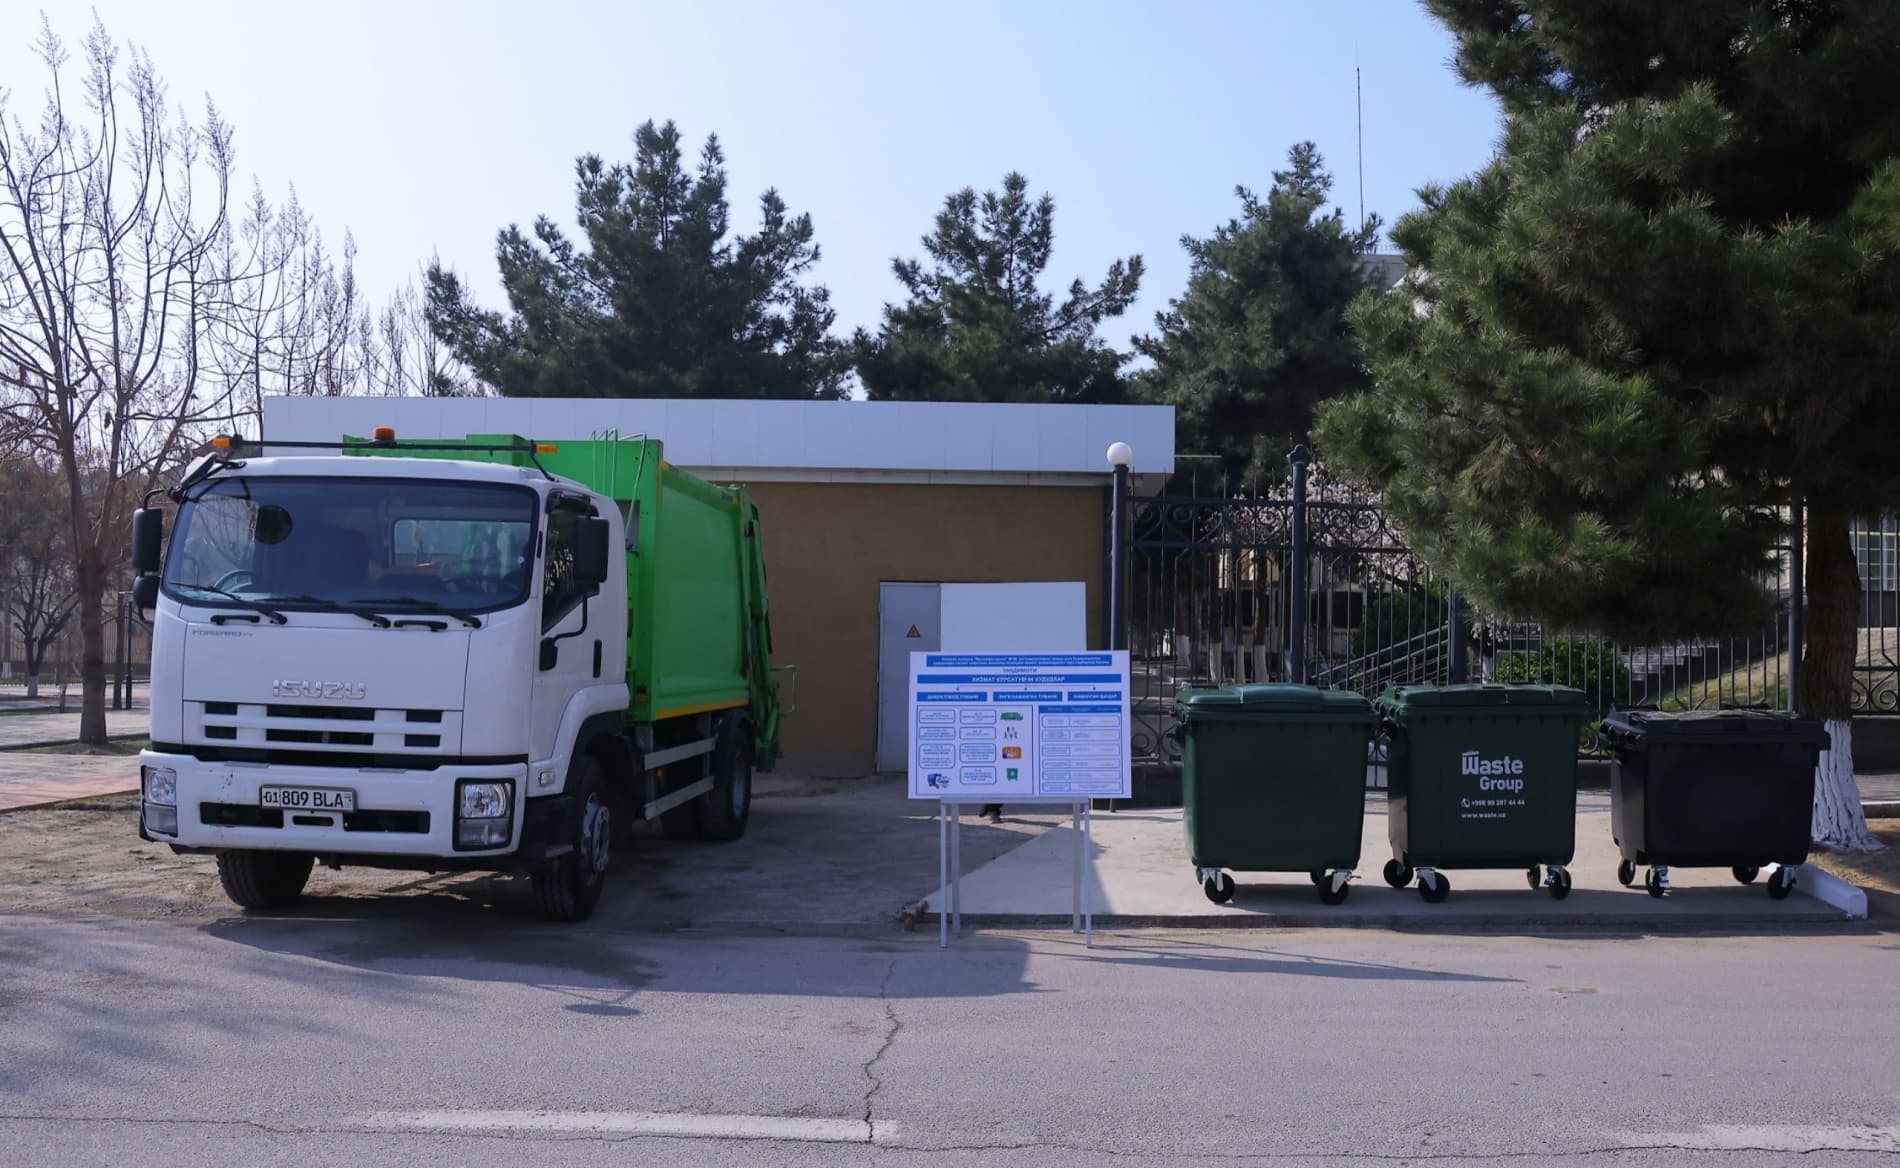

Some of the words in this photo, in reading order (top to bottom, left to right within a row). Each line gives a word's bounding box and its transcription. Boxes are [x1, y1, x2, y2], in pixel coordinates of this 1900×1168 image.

[272, 679, 367, 700] ISUZU
[1462, 751, 1524, 775] Waste
[1480, 776, 1524, 793] Group
[264, 791, 279, 803] 01
[282, 790, 309, 806] 809
[313, 792, 344, 808] BLA
